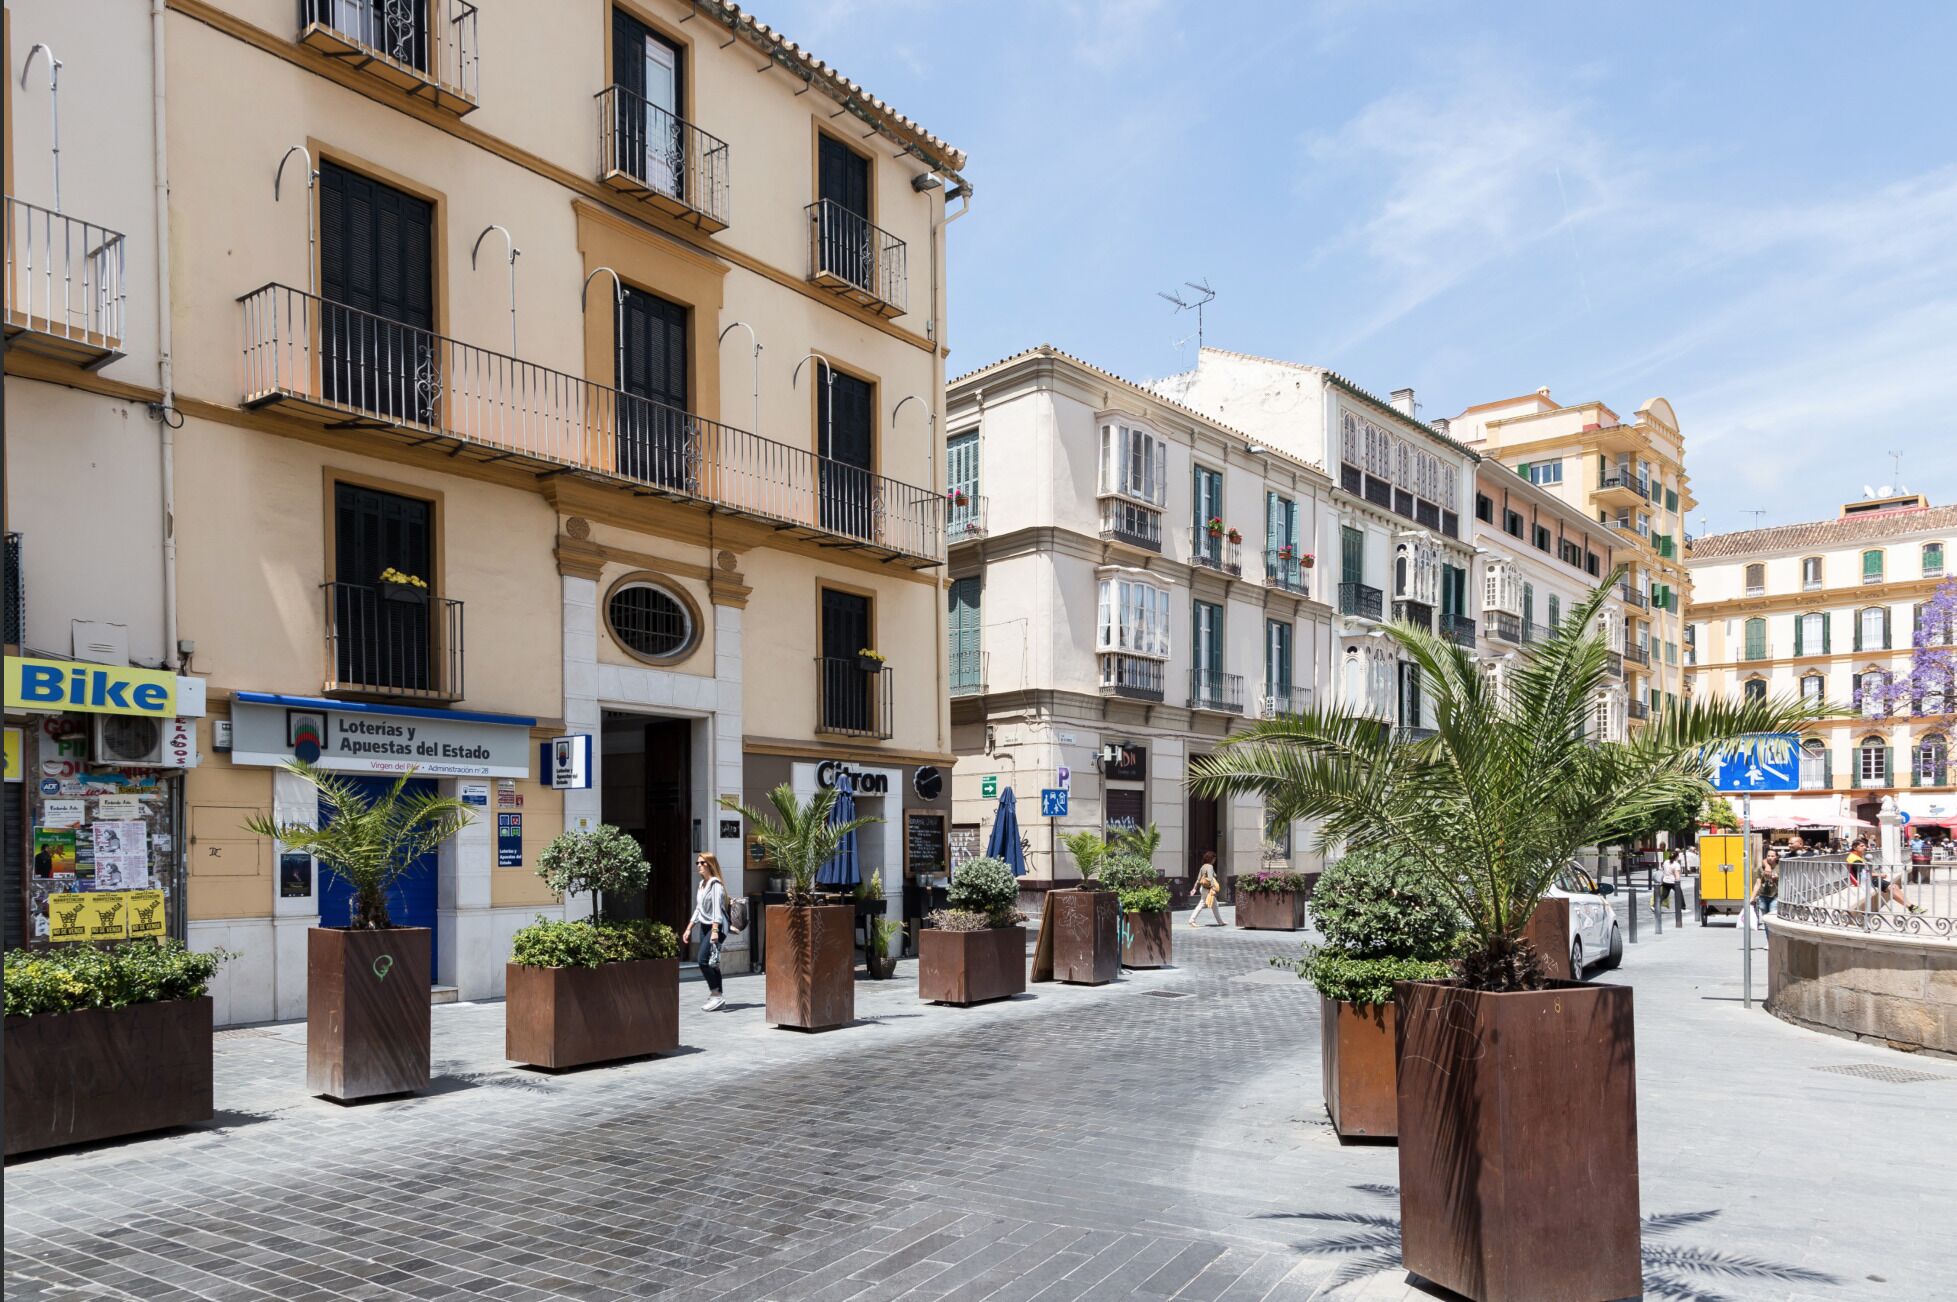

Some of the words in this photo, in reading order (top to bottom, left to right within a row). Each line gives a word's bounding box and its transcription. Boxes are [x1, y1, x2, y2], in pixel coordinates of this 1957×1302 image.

[21, 664, 168, 711] Bike
[339, 719, 403, 737] Loterías
[407, 727, 416, 741] y
[340, 737, 412, 754] Apuestas
[416, 741, 438, 756] del
[442, 744, 490, 760] Estado
[370, 761, 393, 771] Virgen
[395, 762, 405, 770] del
[1058, 767, 1070, 787] P
